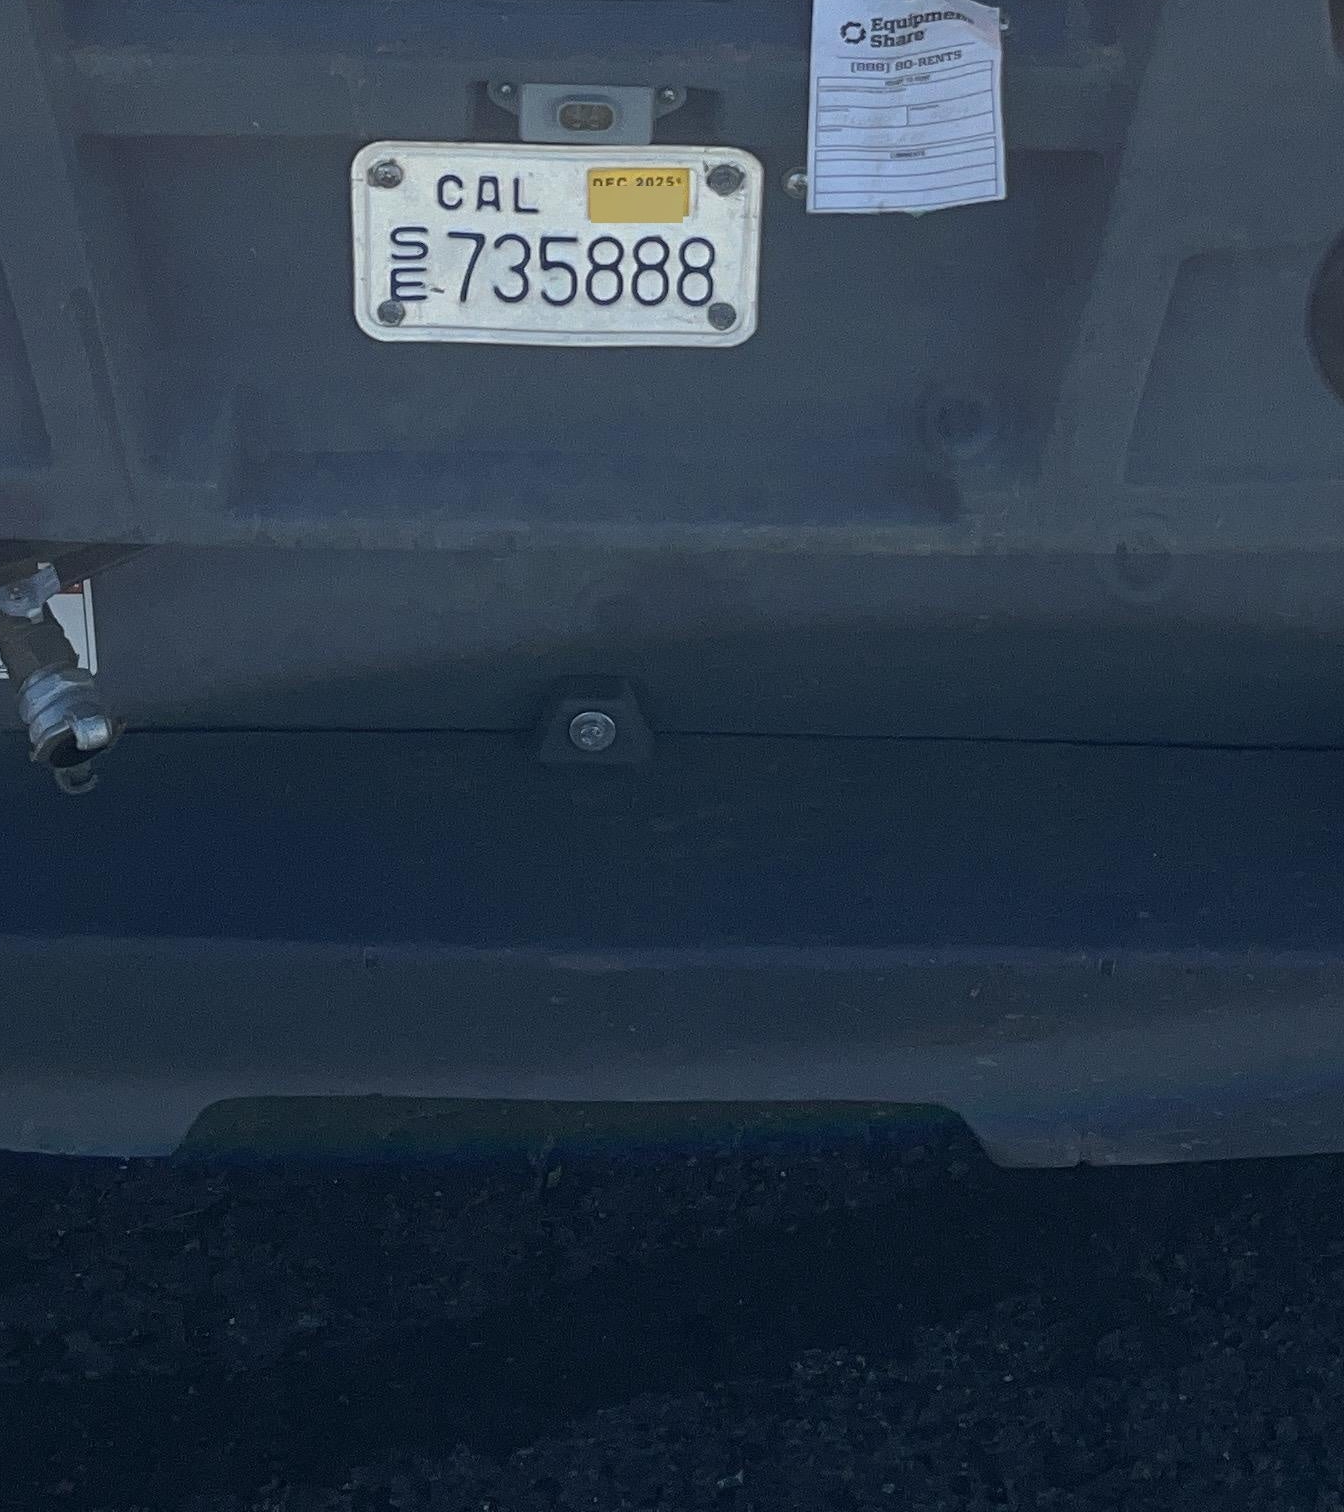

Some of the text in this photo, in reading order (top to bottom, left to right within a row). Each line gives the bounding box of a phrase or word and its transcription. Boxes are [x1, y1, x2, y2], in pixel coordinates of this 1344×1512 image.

[869, 30, 925, 49] Share
[436, 174, 540, 214] CAL
[446, 230, 716, 307] 735888
